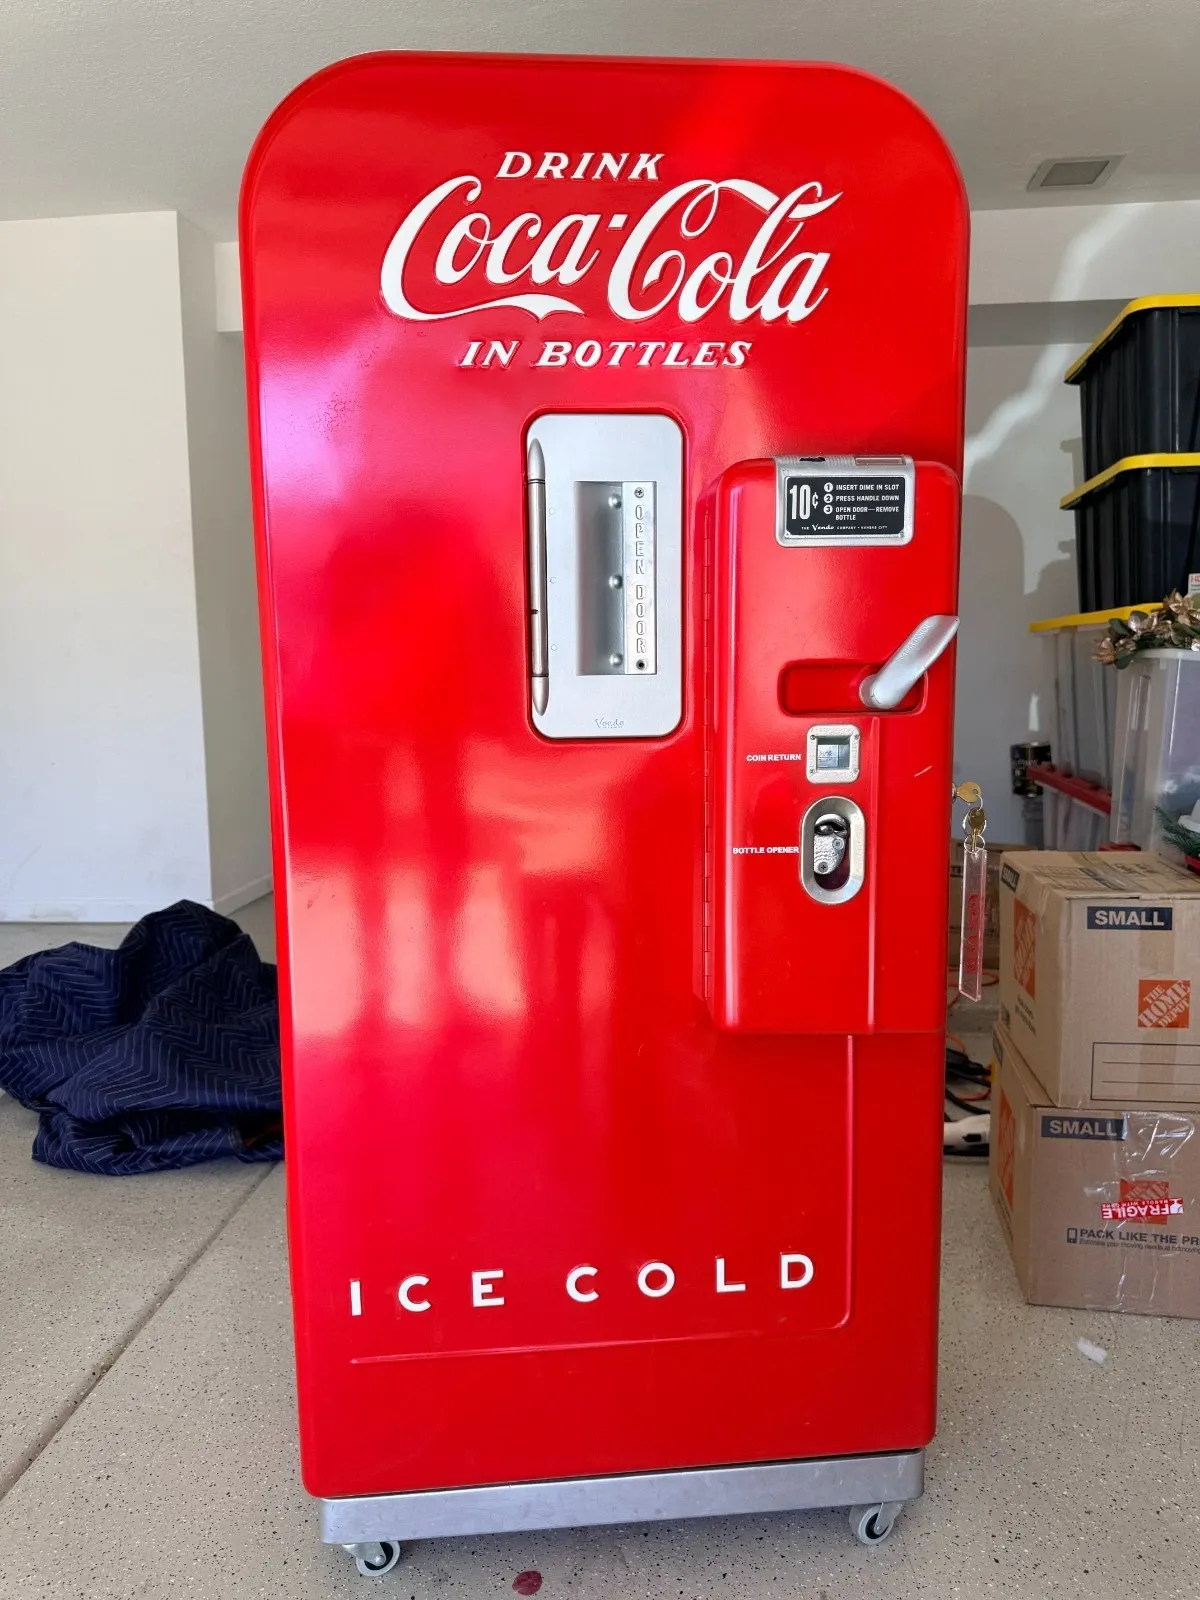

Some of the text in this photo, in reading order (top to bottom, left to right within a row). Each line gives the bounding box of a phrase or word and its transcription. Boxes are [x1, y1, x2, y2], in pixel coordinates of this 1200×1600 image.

[496, 151, 665, 181] DRINK
[380, 174, 844, 323] Coca-Cola
[460, 340, 752, 369] IN BOTTLES
[790, 484, 818, 520] 10¢
[635, 504, 646, 654] OPEN DOOR
[746, 754, 767, 762] COIN
[1094, 910, 1164, 926] SMALL
[1138, 980, 1190, 1027] HOME
[1144, 984, 1165, 1004] THE
[1156, 998, 1189, 1028] DEPOT
[1050, 1120, 1117, 1136] SMALL
[1102, 1204, 1169, 1219] FRAGILE
[1080, 1229, 1114, 1240] PACK
[1119, 1231, 1148, 1242] LIKE
[1152, 1234, 1177, 1244] THE
[350, 1253, 814, 1316] ICE COLD
